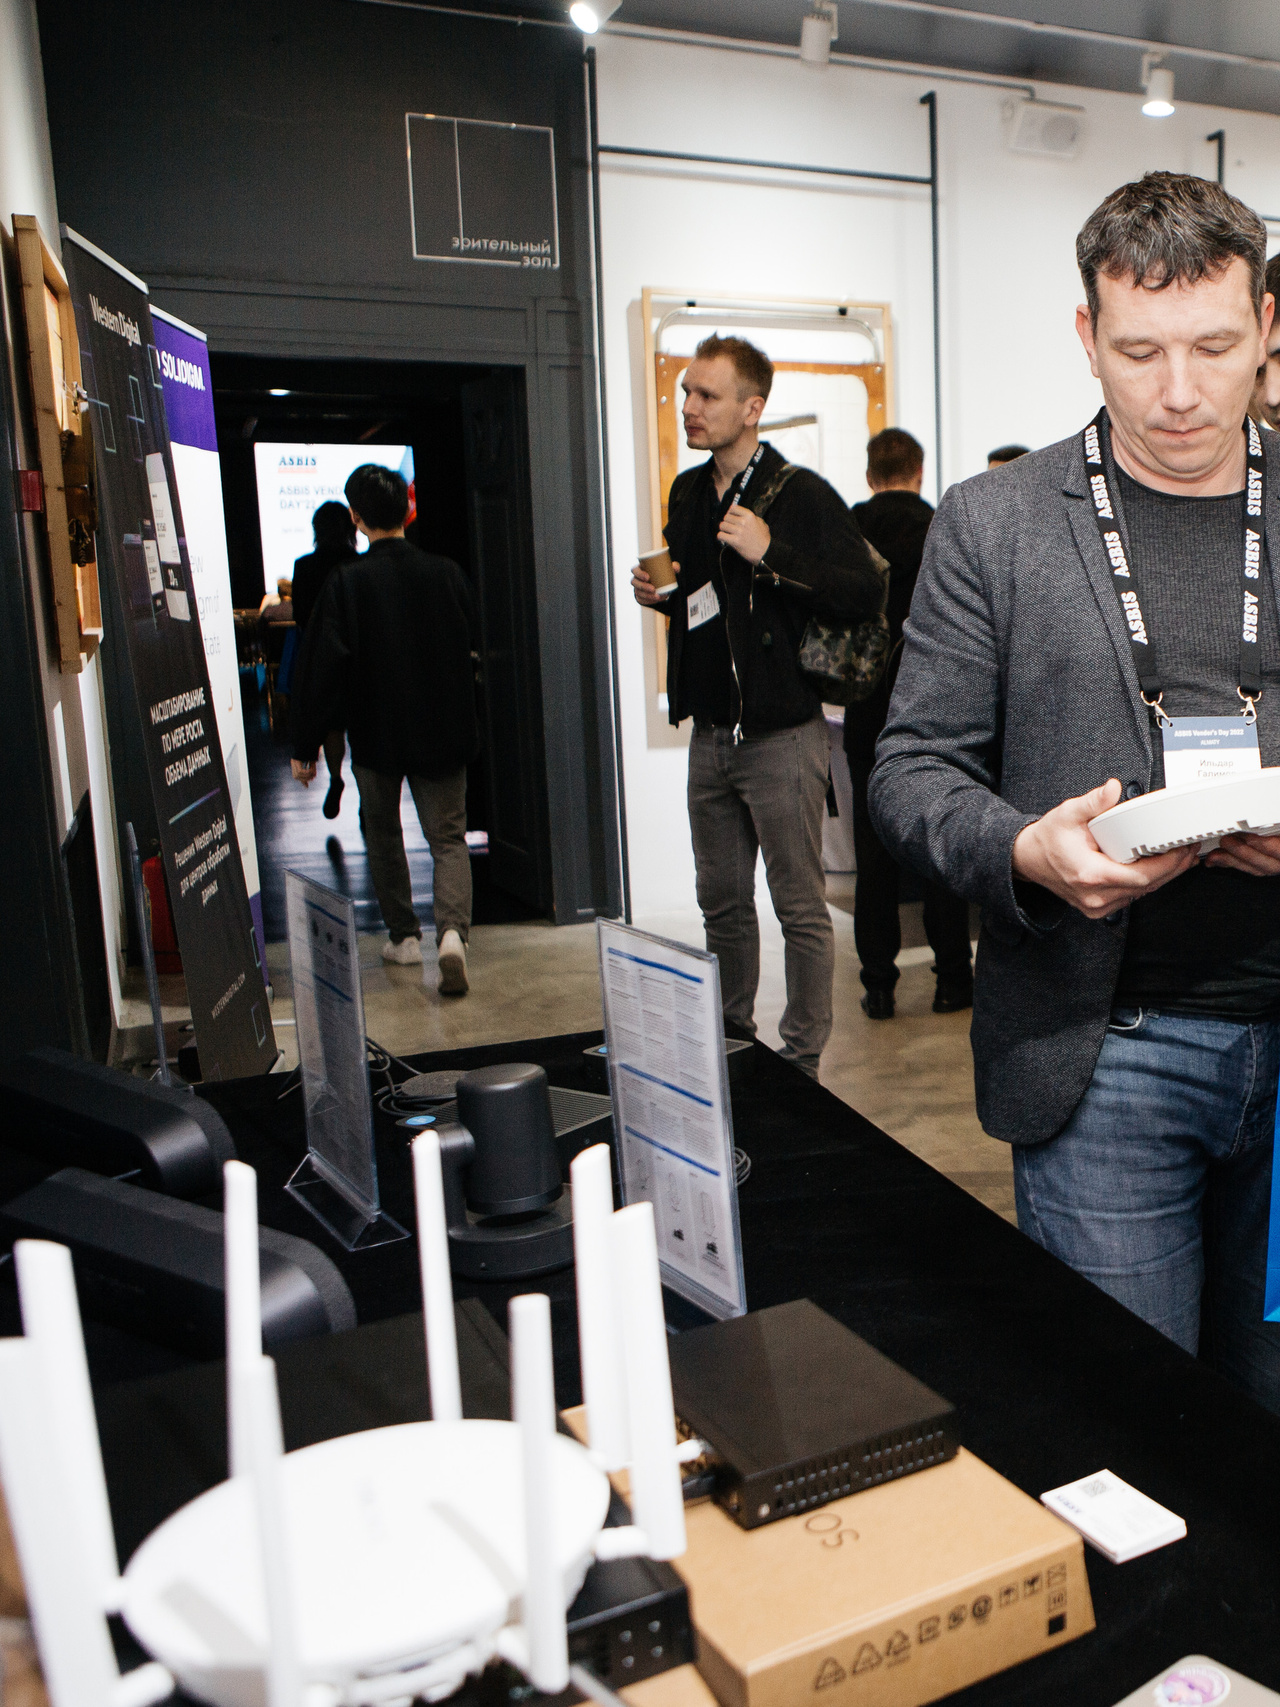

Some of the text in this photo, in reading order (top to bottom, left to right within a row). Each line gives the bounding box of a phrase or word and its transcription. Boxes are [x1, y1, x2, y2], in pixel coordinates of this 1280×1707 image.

[452, 237, 551, 254] зрительный
[522, 255, 551, 268] зал
[89, 293, 142, 347] Western Digital
[278, 456, 317, 466] ASBIS
[1085, 424, 1102, 465] ASBIS
[279, 486, 310, 495] ASBIS
[1090, 474, 1114, 519] ASBIS
[1246, 467, 1263, 516] ASBIS
[1103, 531, 1131, 578] ASBIS
[1244, 528, 1260, 579] ASBIS
[1121, 591, 1149, 645] ASBIS
[1242, 590, 1259, 644] ASBIS
[150, 687, 206, 725] МАСШТАБИРОВАНИЕ
[161, 718, 205, 754] ПО МЕРЕ РОСТА
[1174, 728, 1244, 738] ASBIS Vendor's Day 2022
[165, 745, 212, 787] ОБЪЕМА ДАННЫХ
[193, 829, 214, 852] Western
[211, 814, 227, 840] Digital
